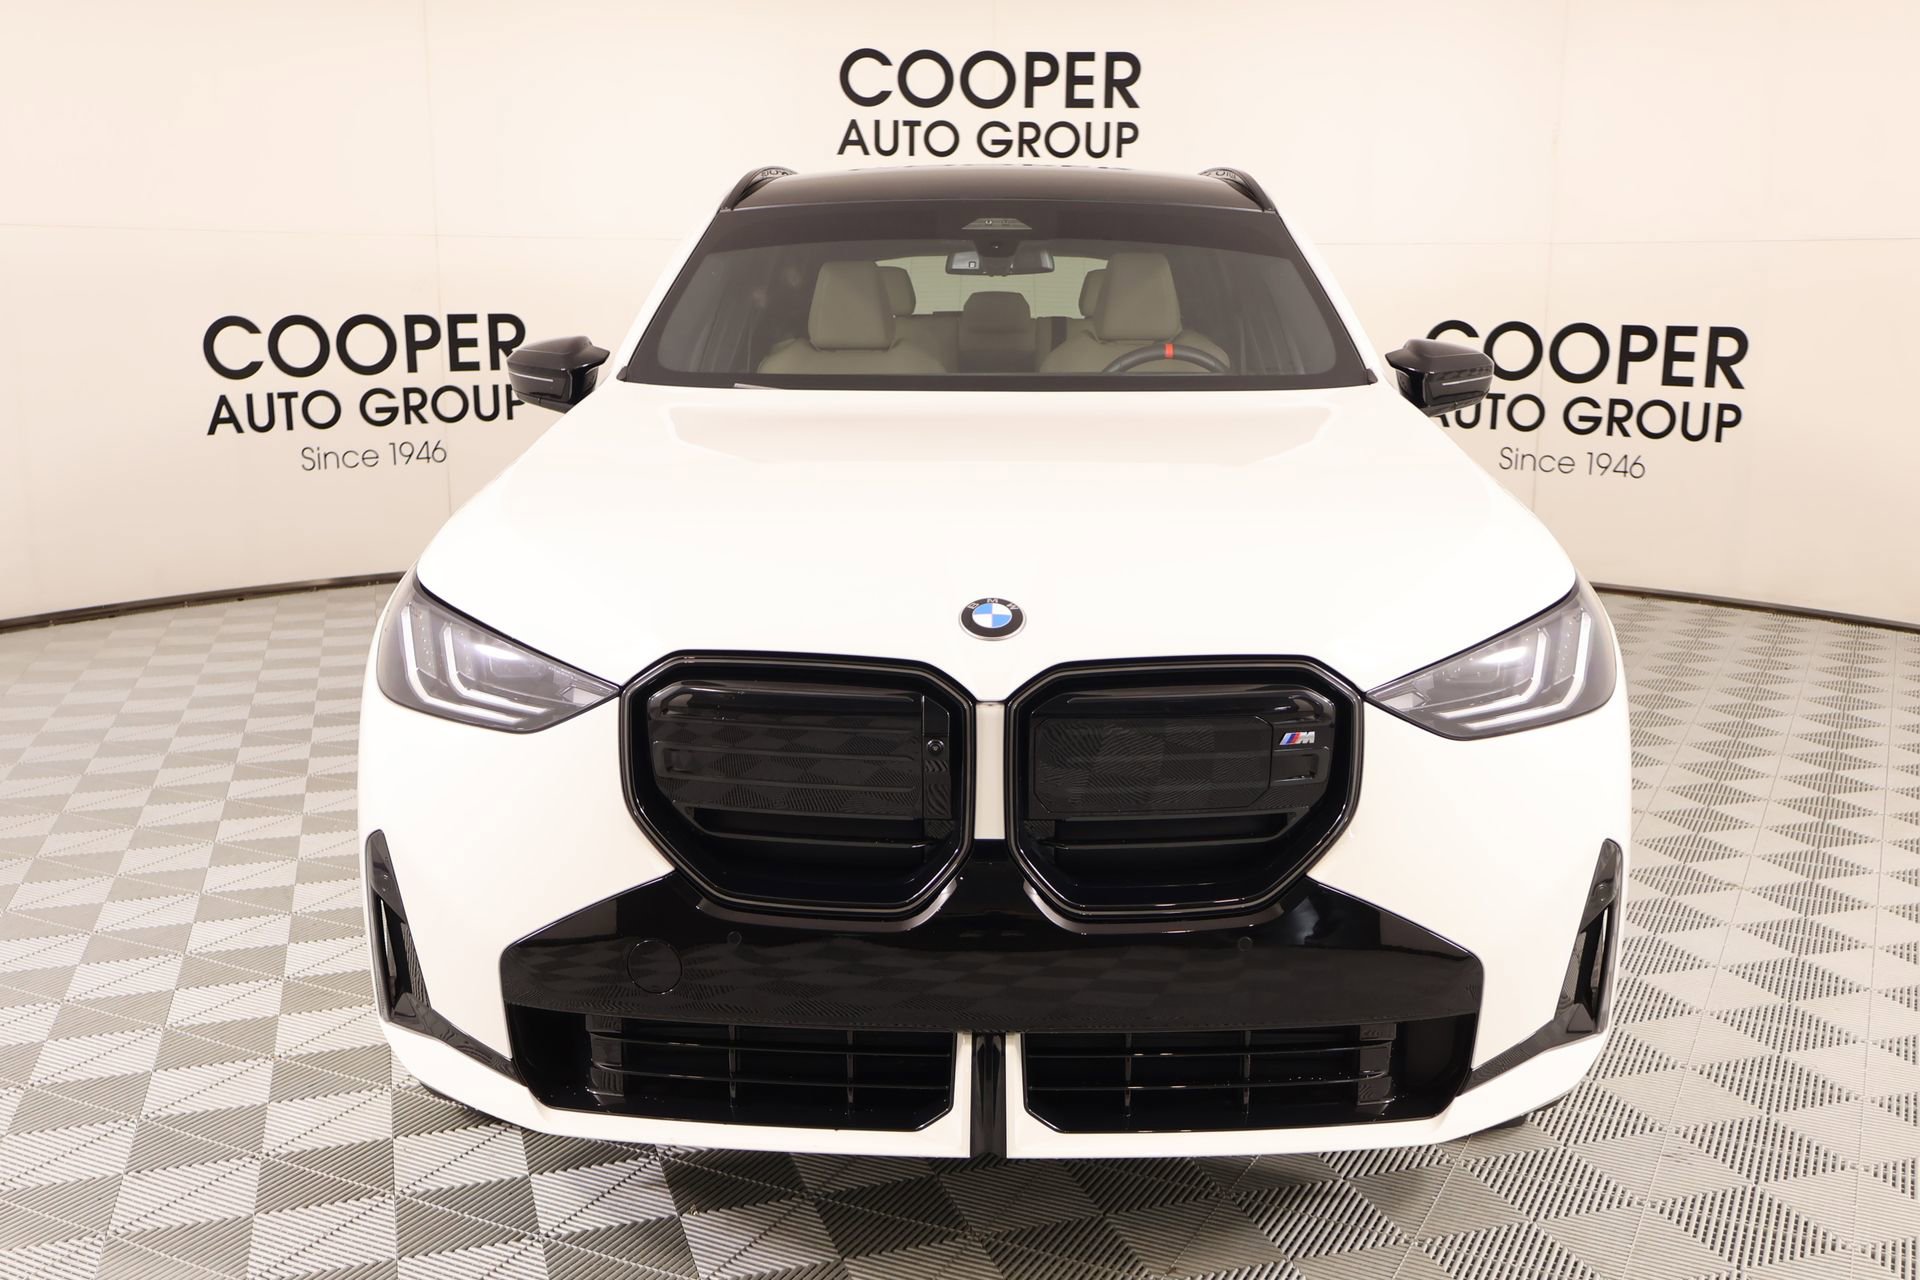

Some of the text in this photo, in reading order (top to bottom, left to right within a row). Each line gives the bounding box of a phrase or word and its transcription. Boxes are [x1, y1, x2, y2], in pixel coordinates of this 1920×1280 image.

[839, 47, 1141, 109] COOPER
[837, 119, 1139, 159] AUTO GROUP
[203, 313, 526, 380] COOPER
[207, 389, 342, 436] AUTO
[1433, 393, 1743, 443] UTO GROUP
[301, 439, 448, 472] Since 1946
[1499, 446, 1646, 480] Since 1946
[967, 598, 1019, 610] BMW
